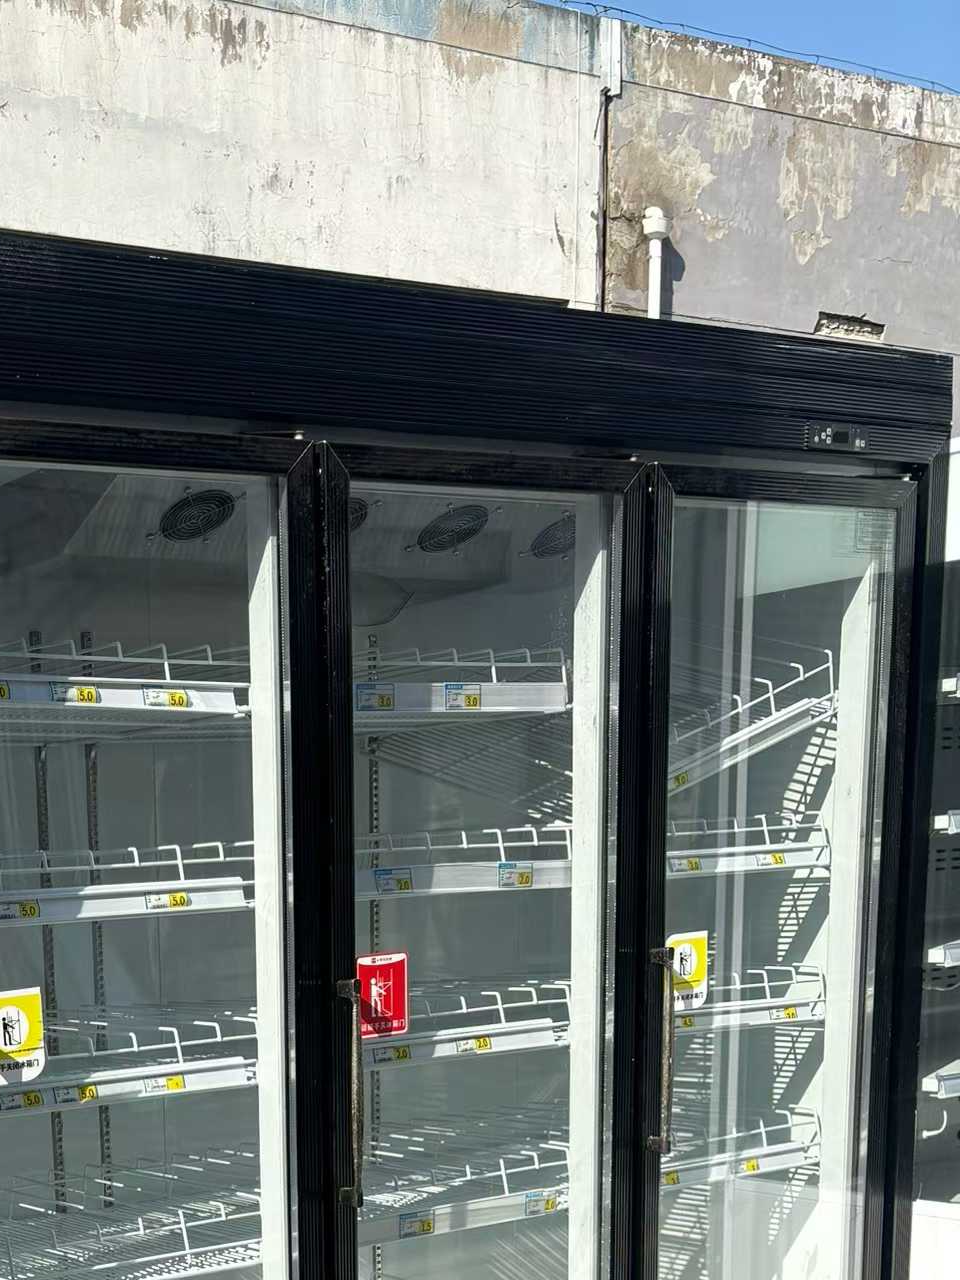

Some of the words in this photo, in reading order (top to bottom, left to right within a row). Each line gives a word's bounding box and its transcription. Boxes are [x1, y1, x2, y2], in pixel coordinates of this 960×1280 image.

[80, 691, 93, 702] 5.0
[171, 695, 184, 706] 5.0
[466, 696, 478, 706] 3.0
[172, 896, 185, 906] 5.0
[22, 907, 36, 917] 5.0
[478, 1039, 488, 1049] 2.0
[26, 1095, 40, 1105] 5.0
